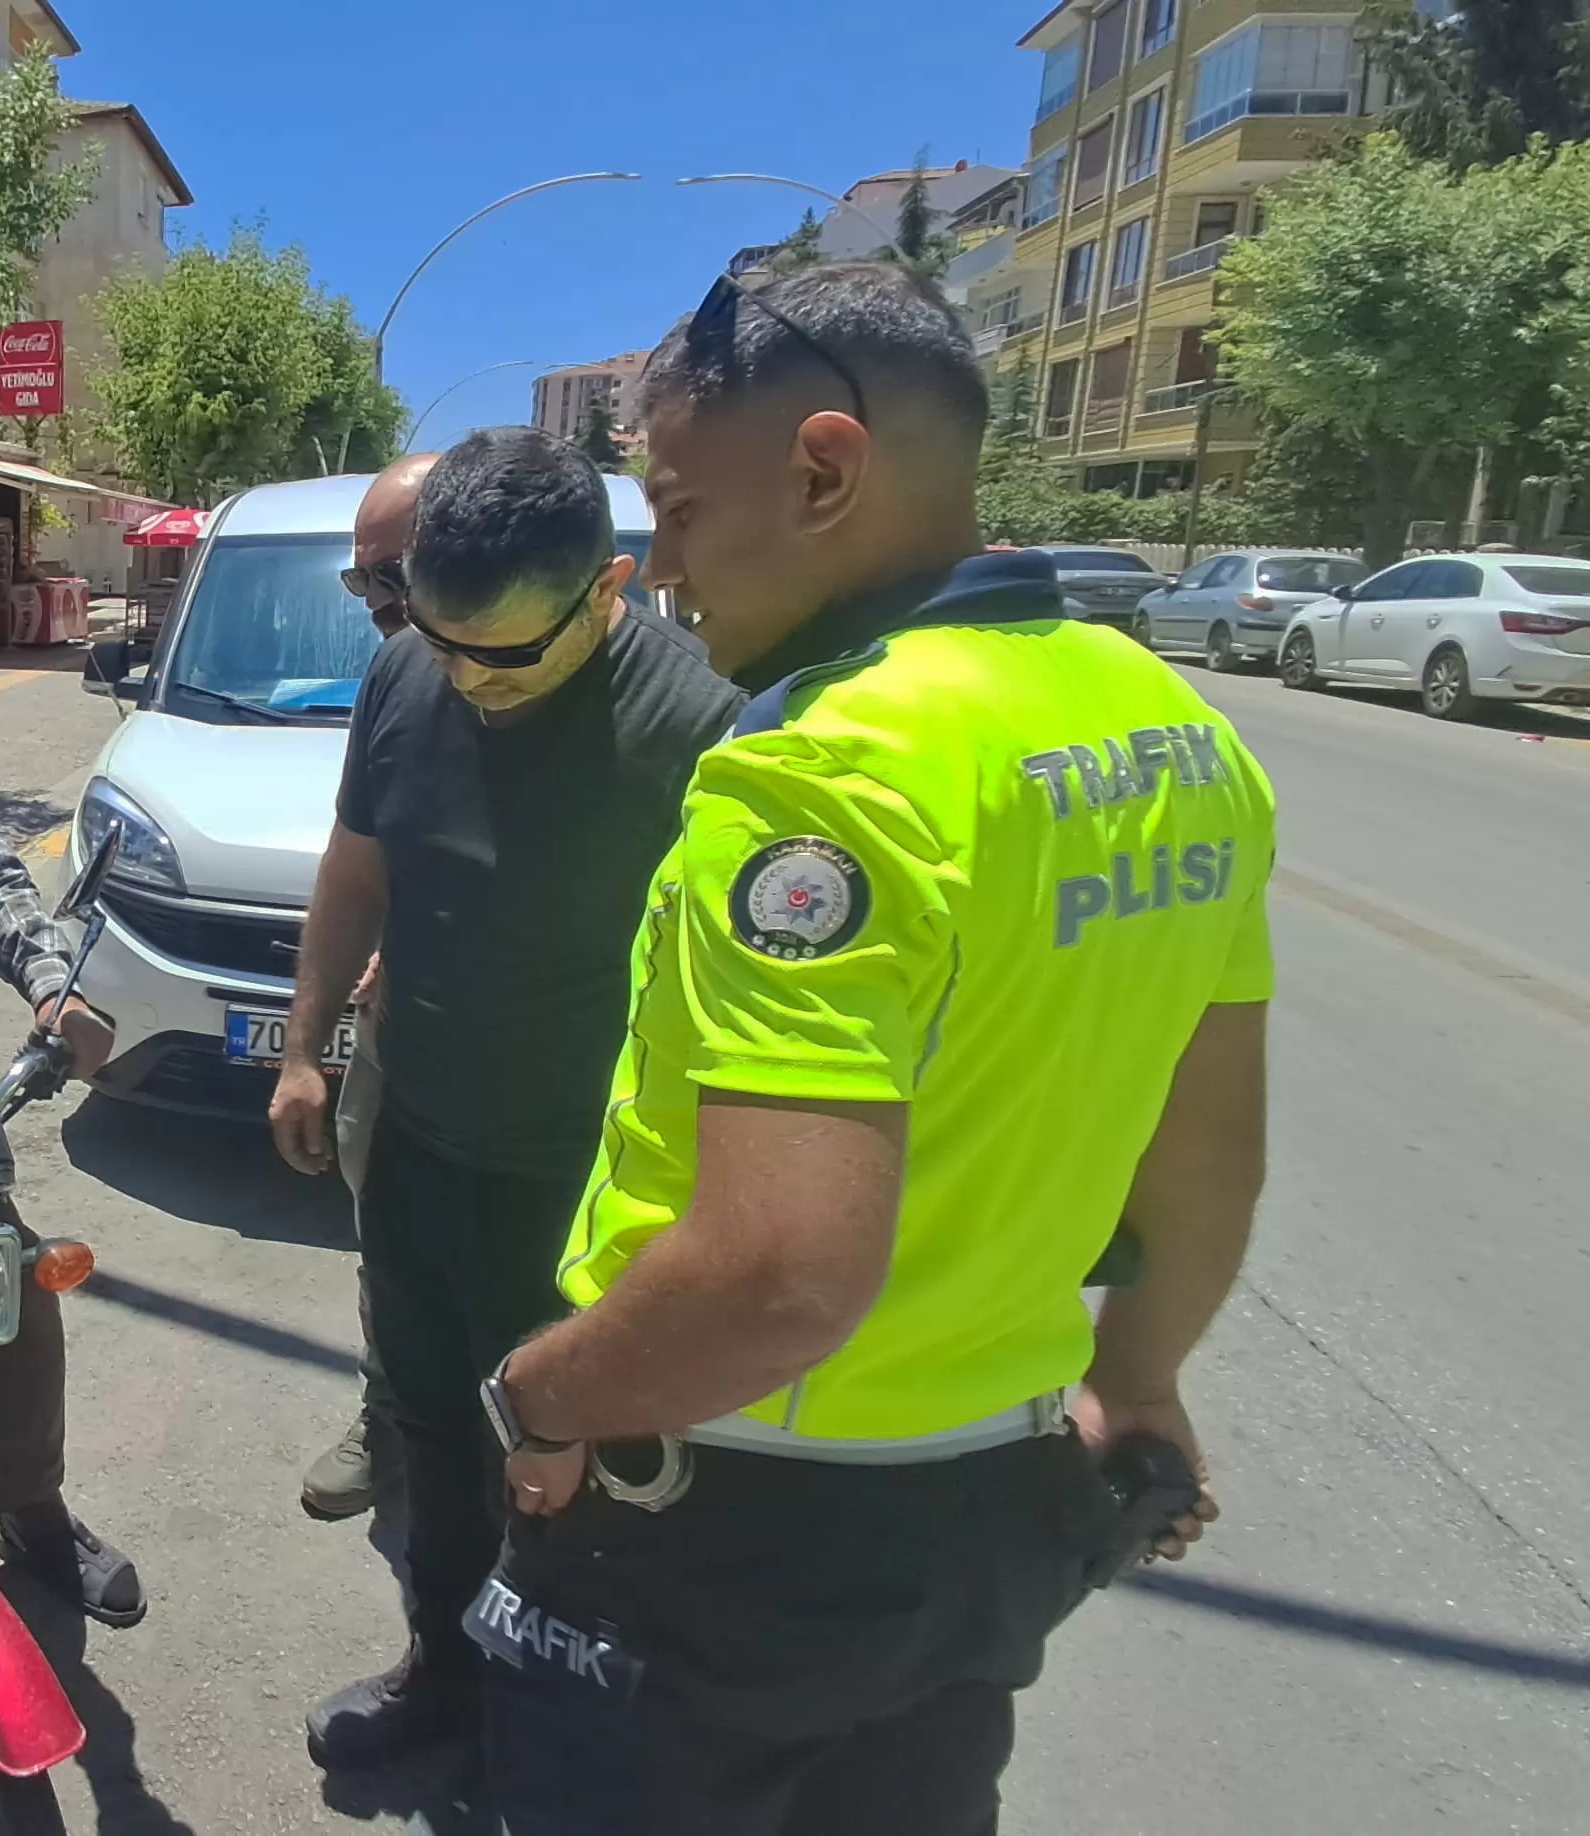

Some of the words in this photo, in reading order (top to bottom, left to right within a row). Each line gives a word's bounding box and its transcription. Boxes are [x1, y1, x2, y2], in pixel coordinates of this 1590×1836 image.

[3, 333, 52, 353] Coca-Cola
[15, 391, 39, 407] GIDA
[1021, 723, 1229, 819] TRAFİK
[1055, 836, 1236, 949] PLİSİ
[248, 1020, 286, 1054] 70
[478, 1577, 613, 1689] TRAFİK
